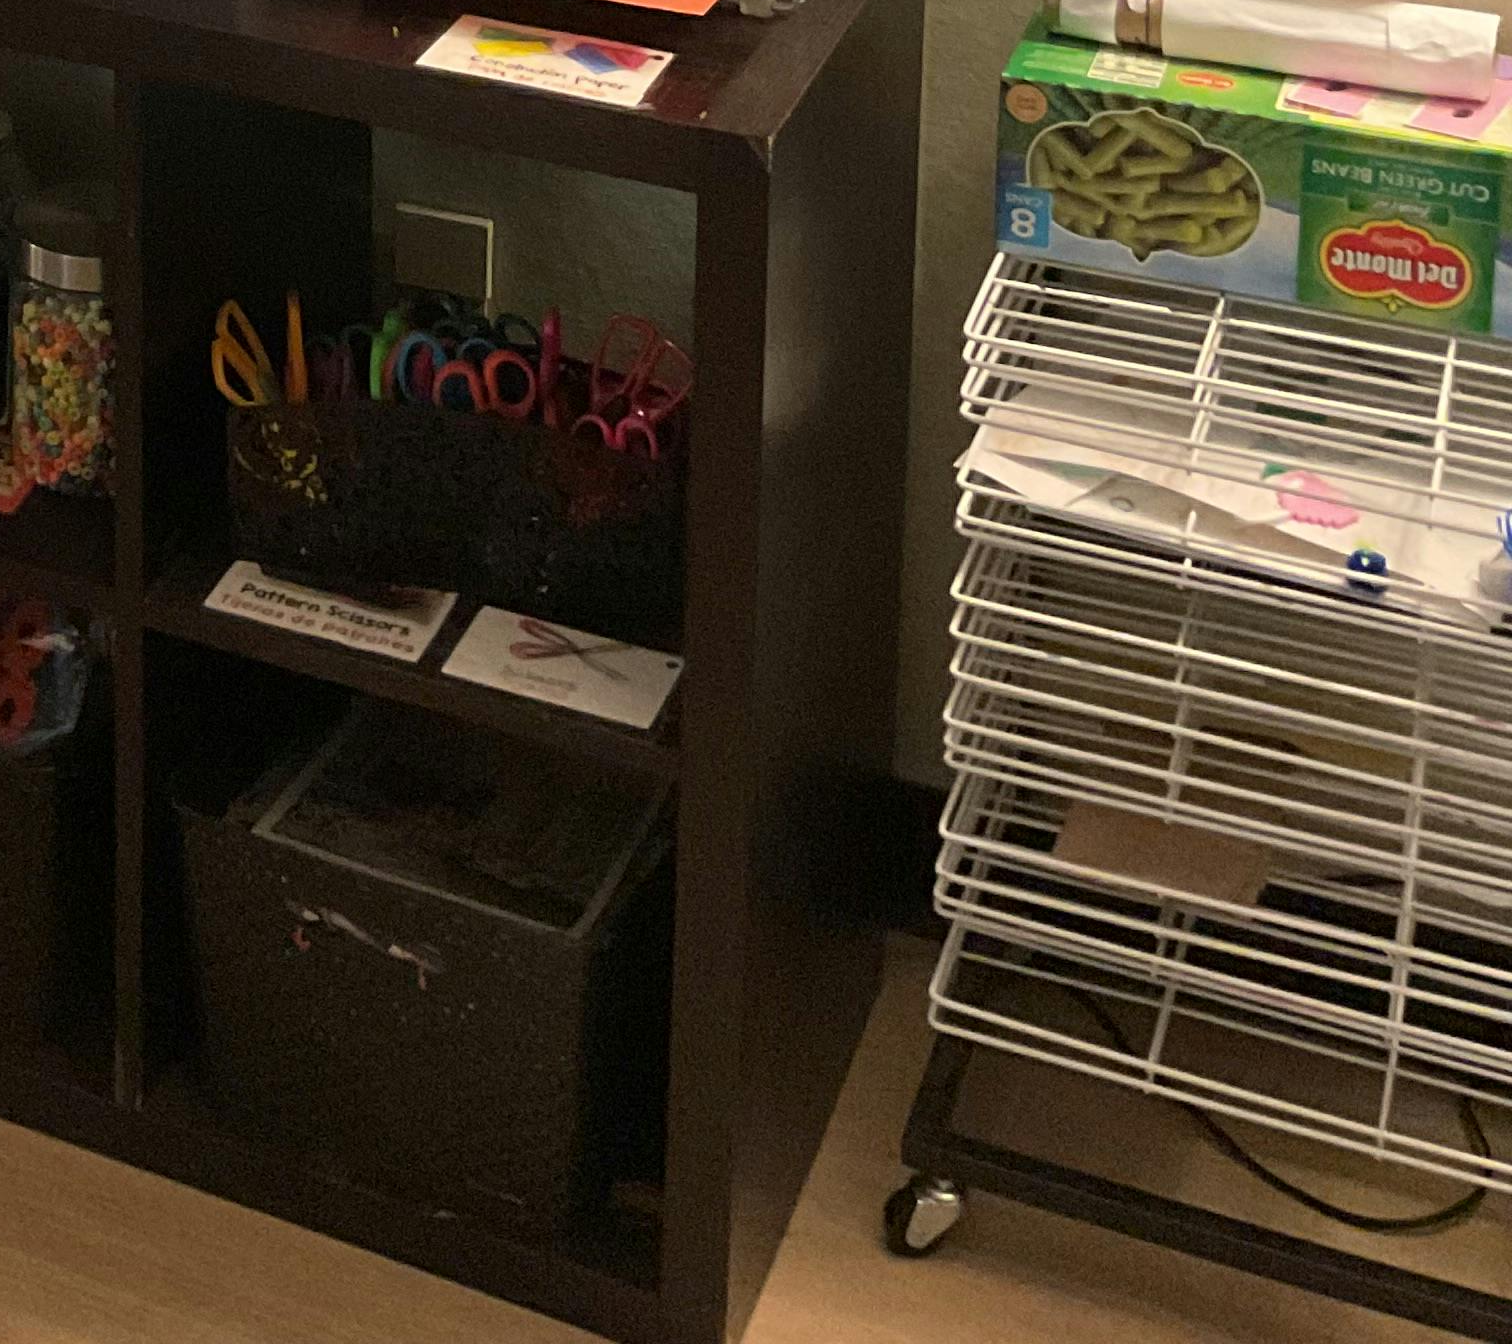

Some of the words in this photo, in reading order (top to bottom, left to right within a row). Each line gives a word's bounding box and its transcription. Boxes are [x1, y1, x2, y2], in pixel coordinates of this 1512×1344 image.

[1311, 158, 1373, 184] BEANS
[1378, 169, 1445, 195] GREEN
[1004, 191, 1043, 208] CANS
[1450, 181, 1491, 203] CUT
[1010, 208, 1037, 239] 8
[1330, 246, 1414, 283] Monte
[1417, 260, 1458, 290] Del
[239, 581, 322, 613] Pattern
[326, 604, 411, 637] Scissors
